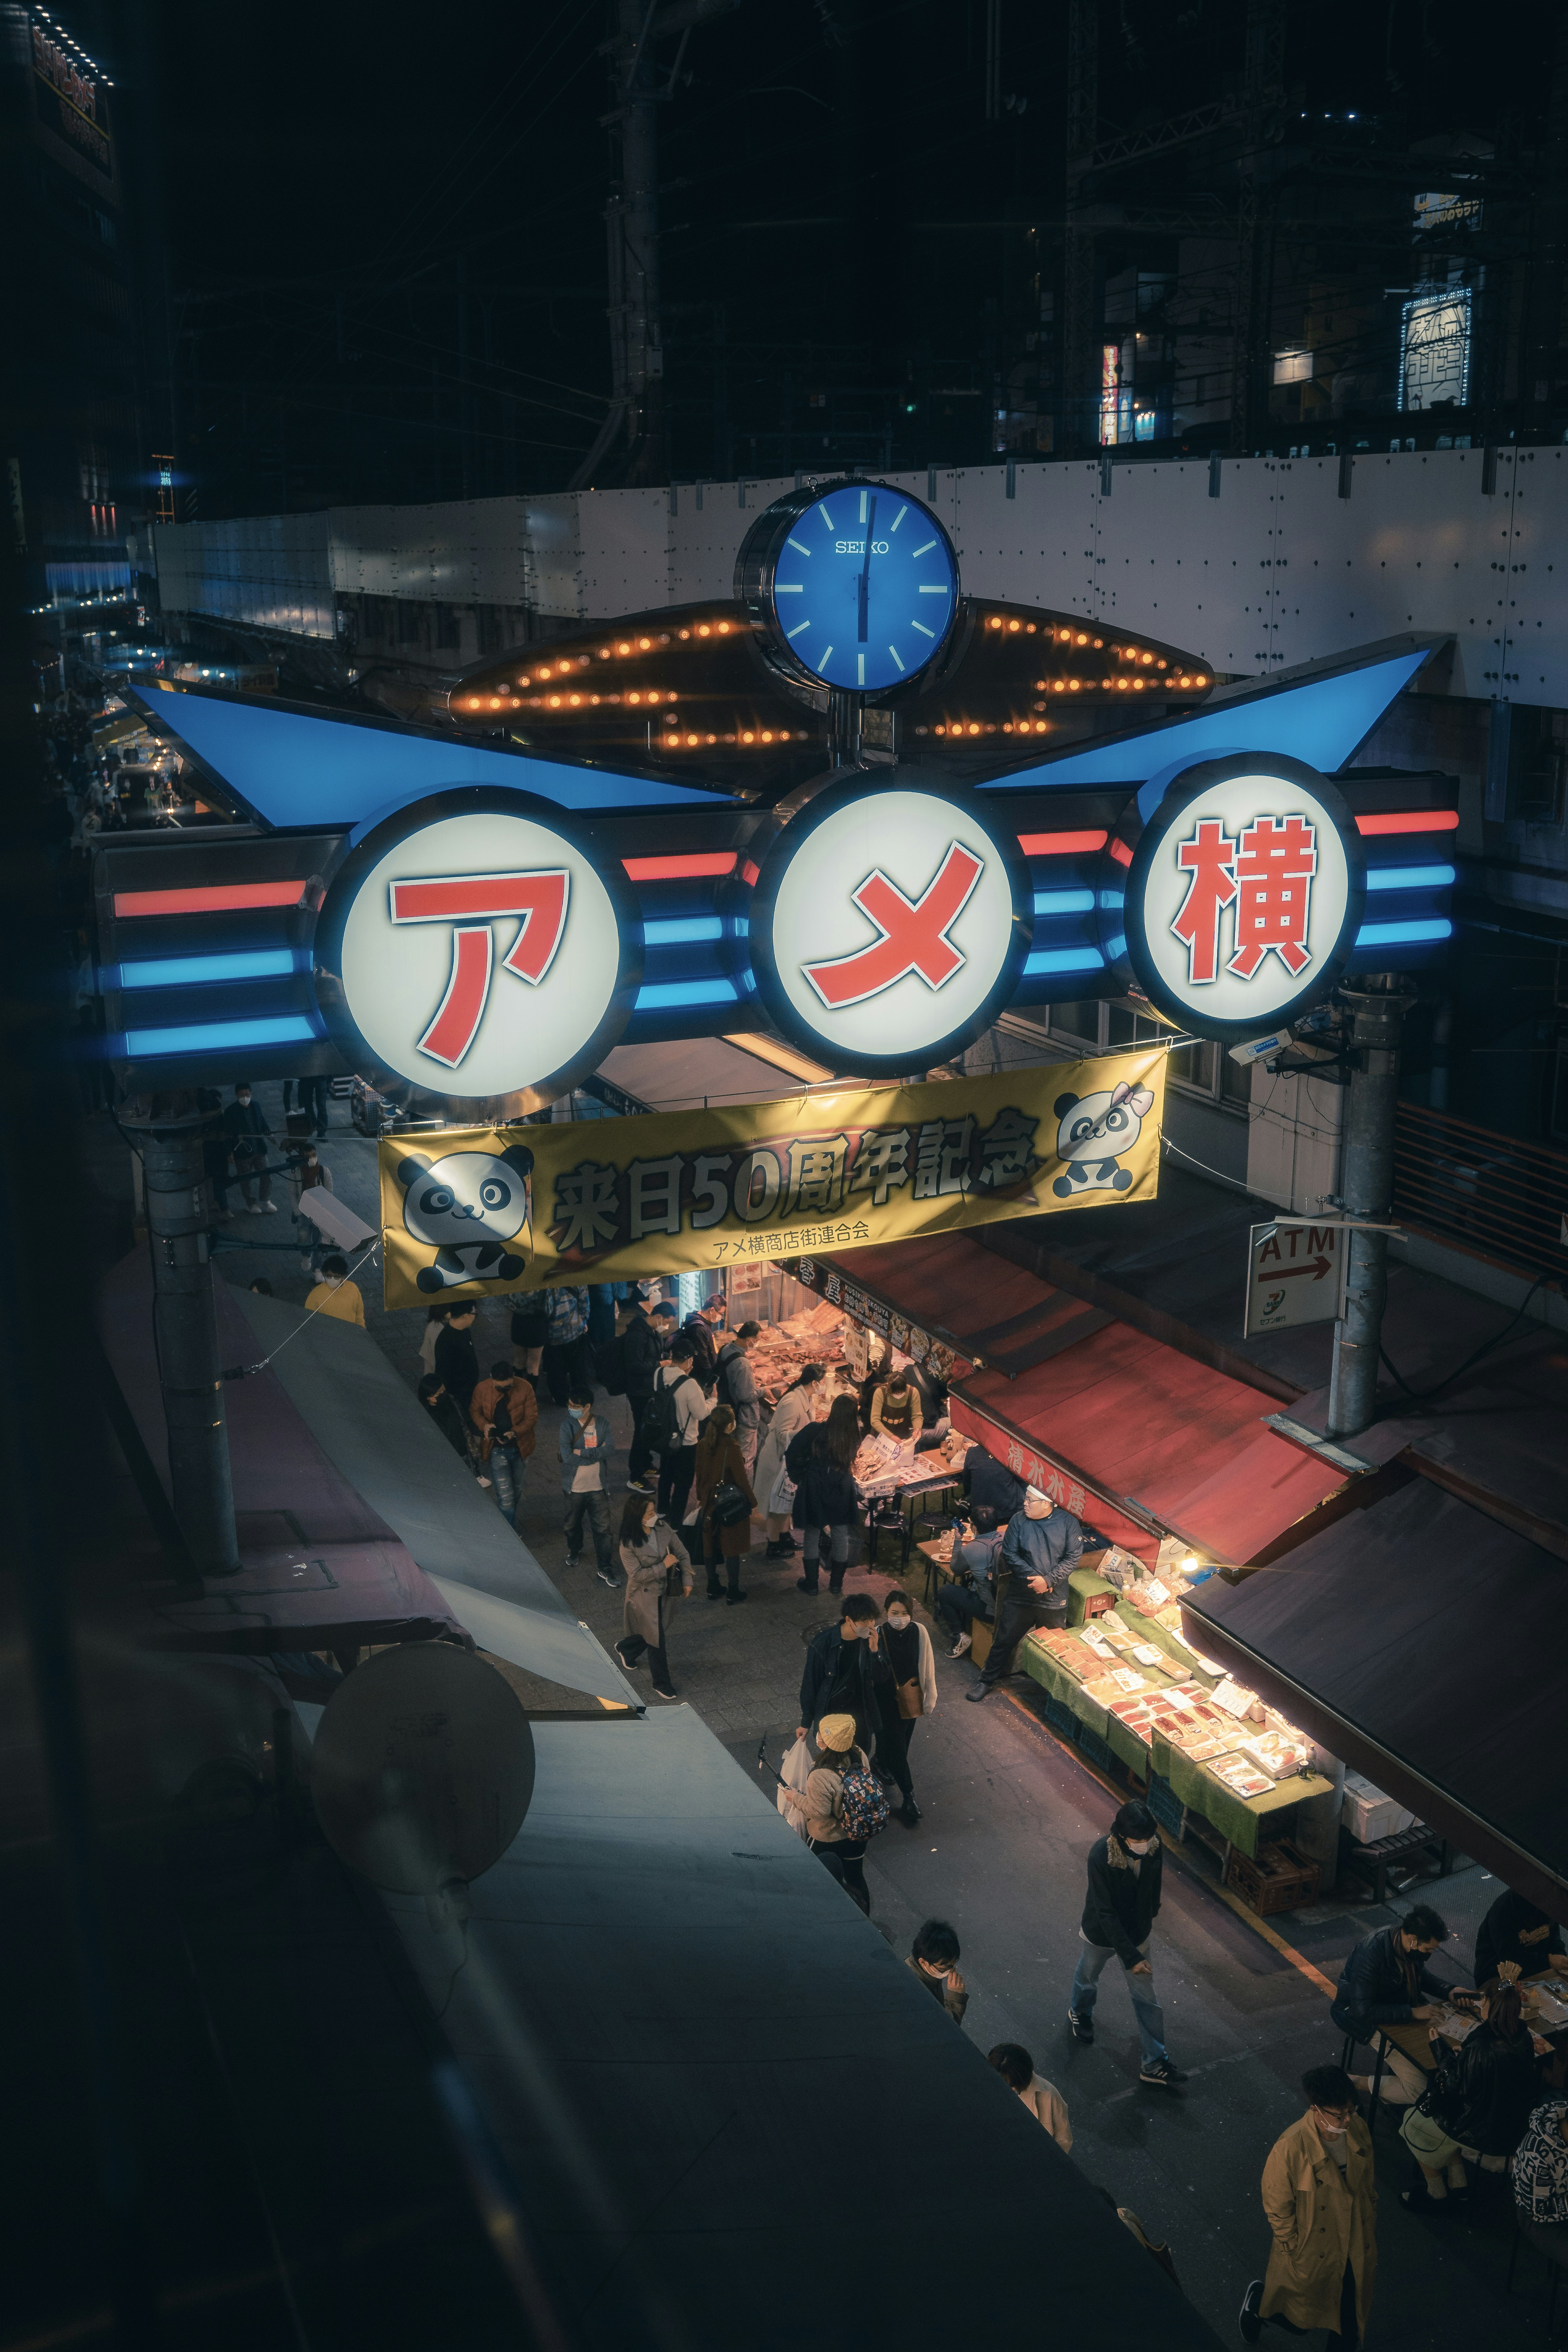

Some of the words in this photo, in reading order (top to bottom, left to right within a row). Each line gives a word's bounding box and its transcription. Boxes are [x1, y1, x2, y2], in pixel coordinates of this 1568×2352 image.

[390, 815, 1316, 1069] アメ横
[555, 1107, 1040, 1252] 来日50周年記念
[713, 1220, 869, 1260] アメ横商店街連合会
[1259, 1226, 1335, 1264] ATM
[845, 1284, 889, 1319] KUSIKUSIKOUYA
[1008, 1439, 1086, 1520] 清水水産
